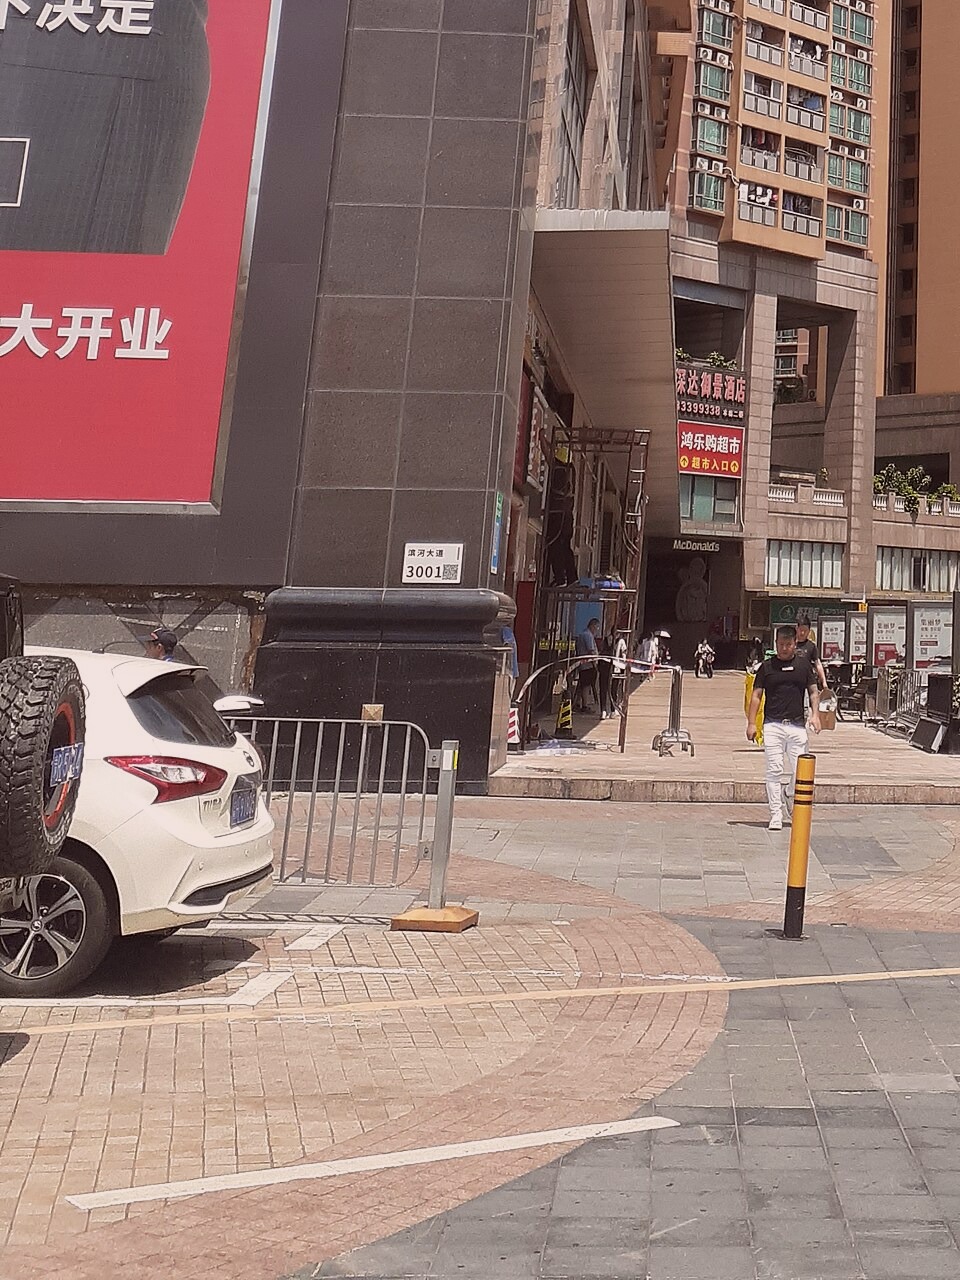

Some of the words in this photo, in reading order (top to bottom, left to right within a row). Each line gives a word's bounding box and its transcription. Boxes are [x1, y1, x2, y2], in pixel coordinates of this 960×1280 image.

[0, 303, 173, 360] 大开业
[681, 431, 740, 454] 鸿乐购超市
[692, 456, 729, 471] 超市入口
[673, 539, 720, 552] McDonald's
[407, 548, 444, 558] 滨河大道
[406, 565, 442, 578] 3001
